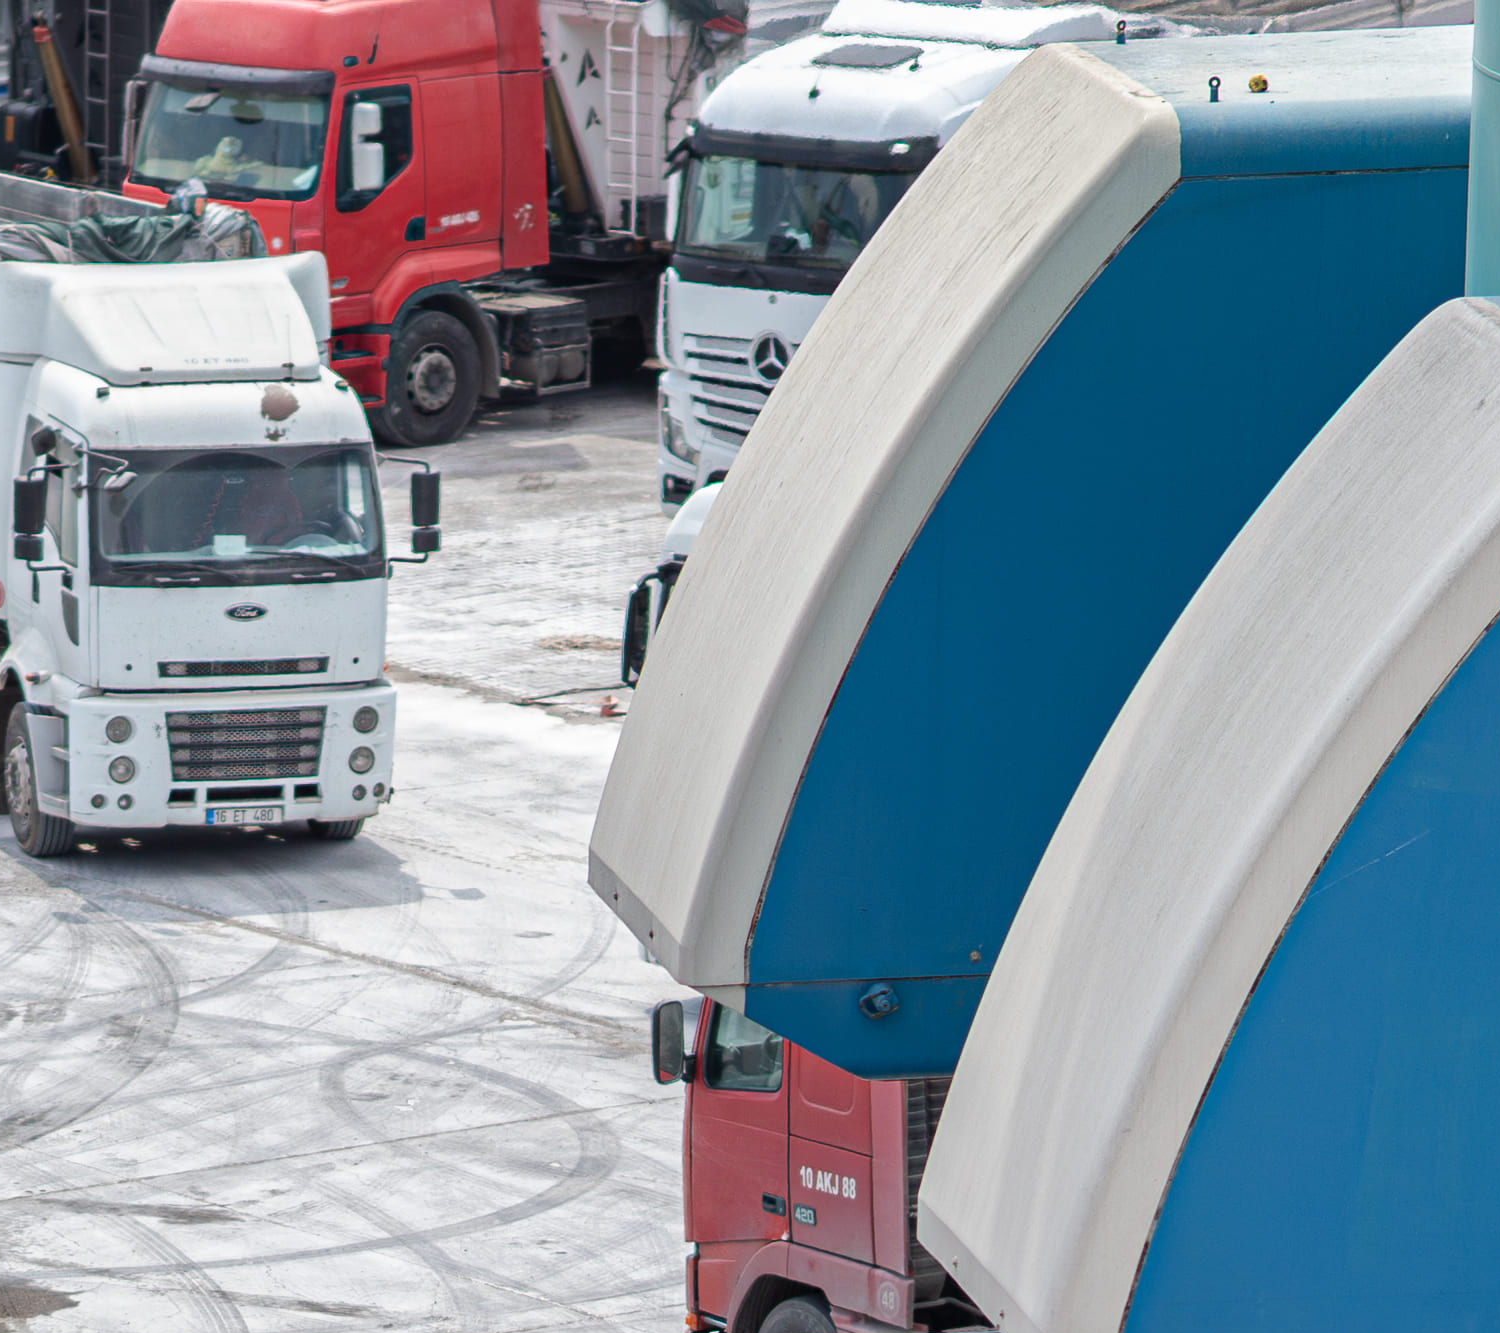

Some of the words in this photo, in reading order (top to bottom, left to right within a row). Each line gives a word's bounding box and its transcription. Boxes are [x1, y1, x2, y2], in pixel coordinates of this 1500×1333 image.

[215, 810, 226, 823] 16
[233, 809, 247, 824] ET
[254, 808, 274, 822] 480
[800, 1165, 813, 1188] 10
[816, 1170, 839, 1195] AKJ
[842, 1176, 856, 1199] 88
[795, 1207, 814, 1225] 420
